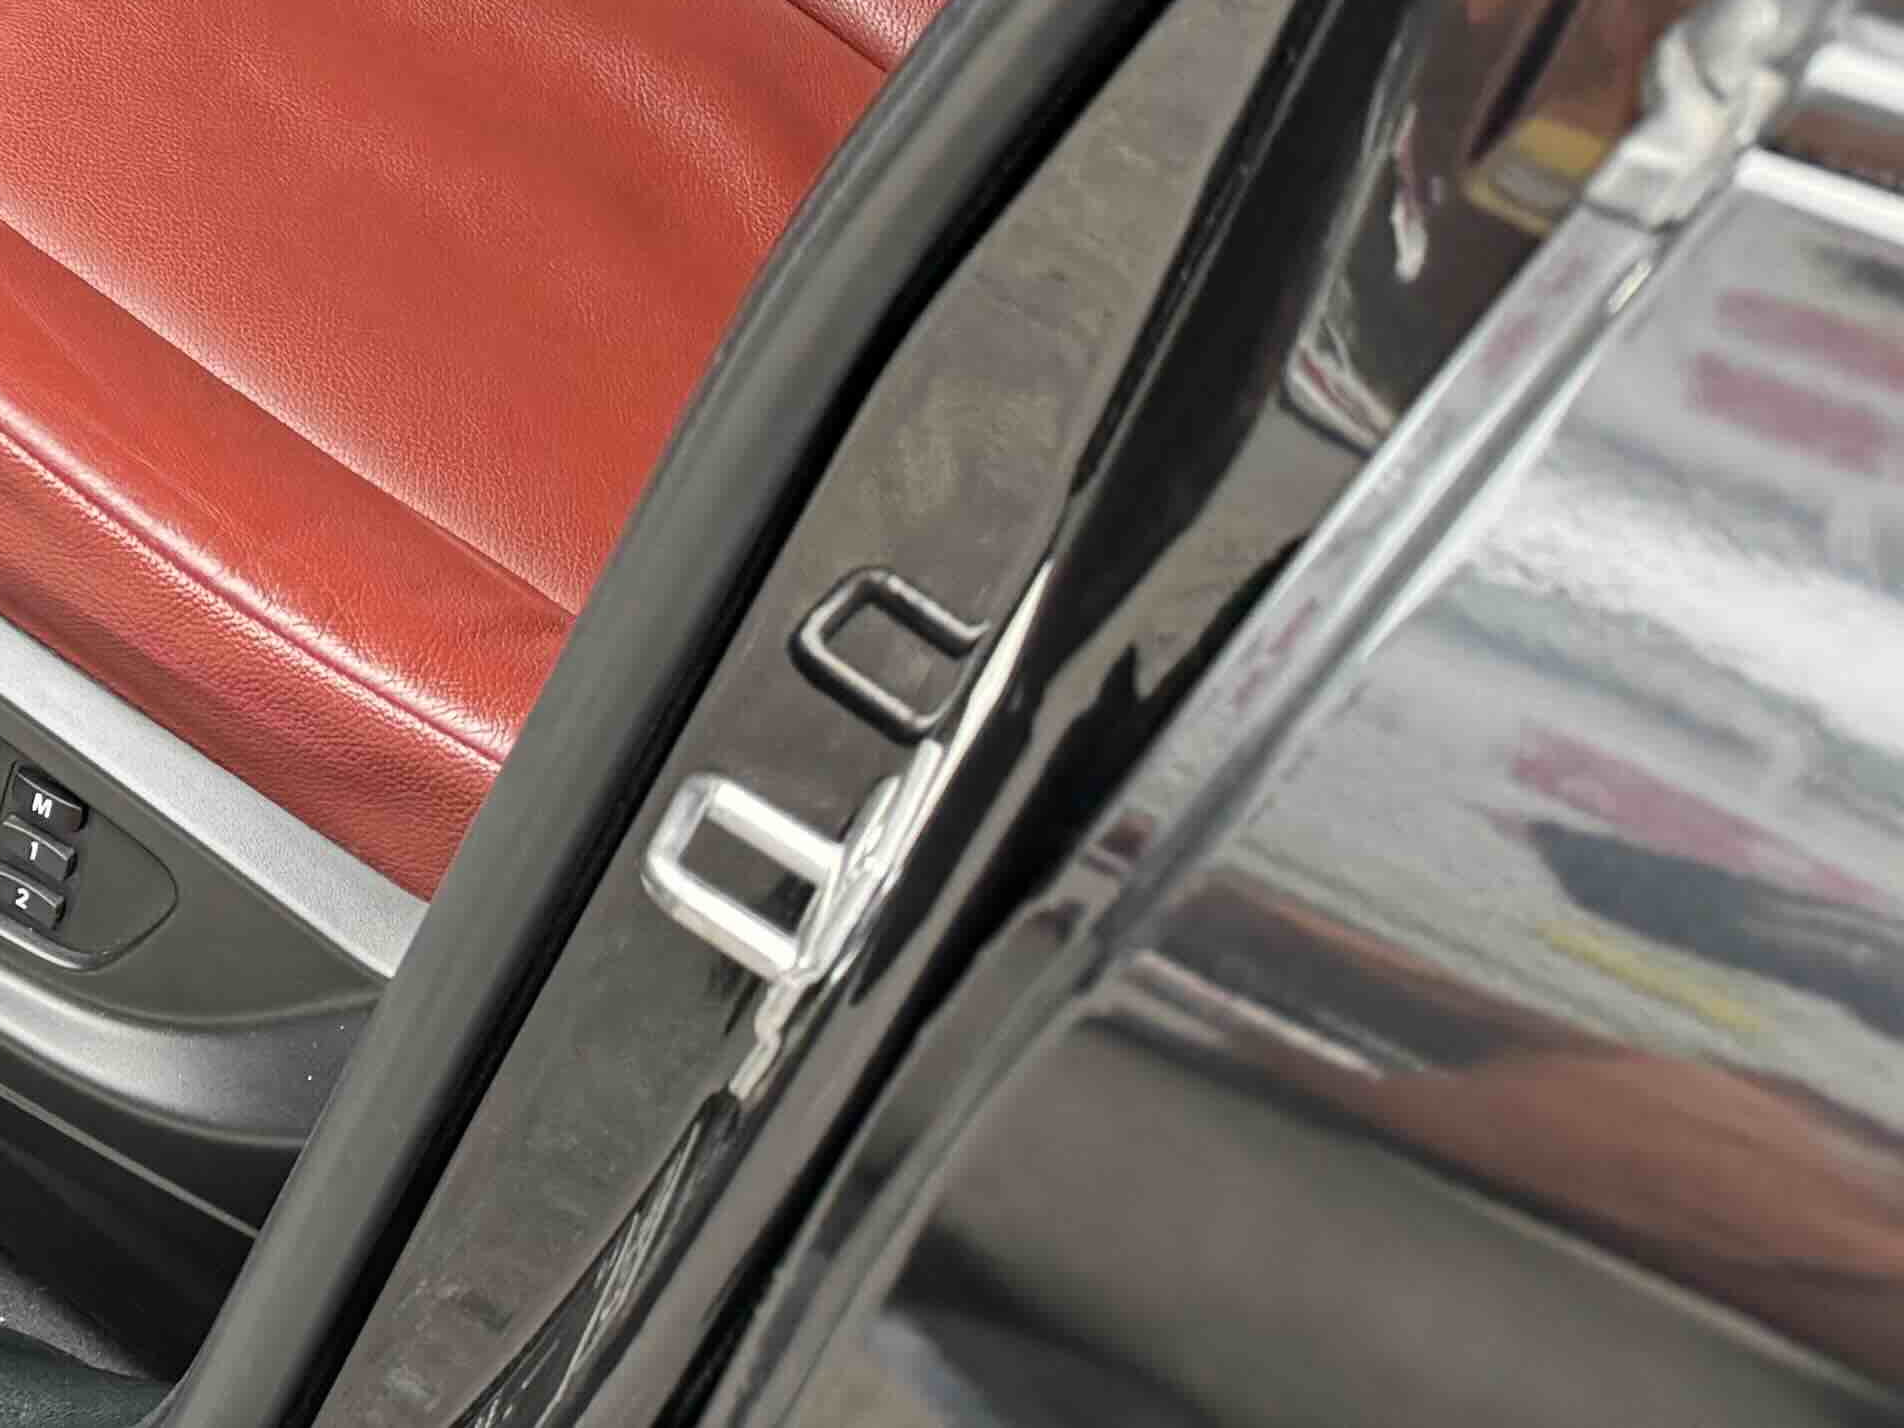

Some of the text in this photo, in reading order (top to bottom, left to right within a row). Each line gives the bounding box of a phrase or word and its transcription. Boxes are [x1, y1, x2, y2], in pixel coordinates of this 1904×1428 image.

[31, 792, 52, 819] M
[29, 841, 39, 861] 1
[15, 887, 30, 910] 2
